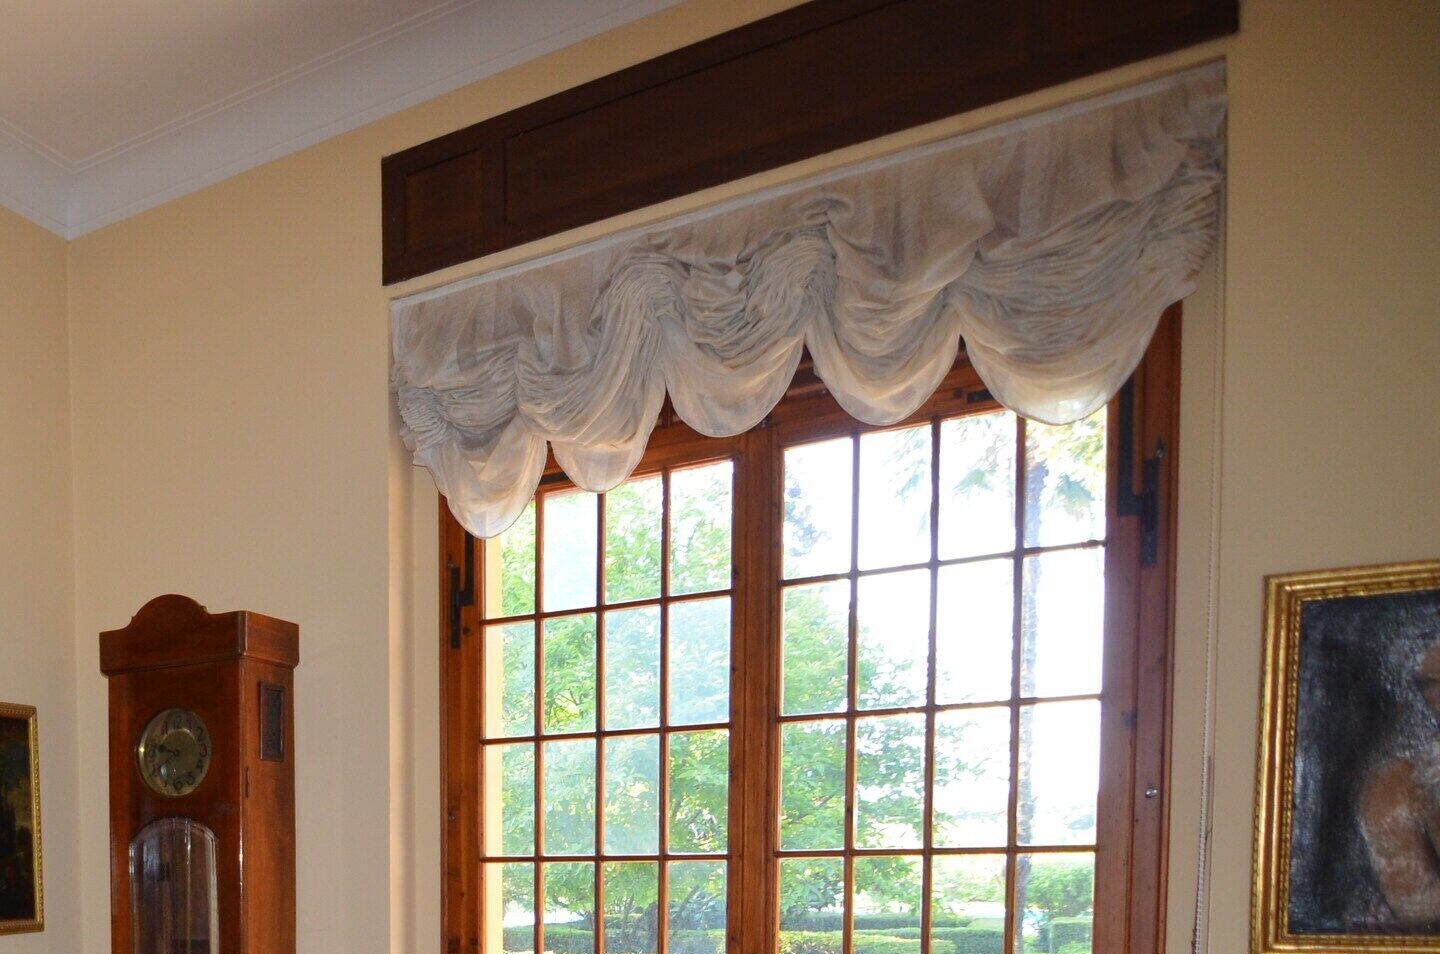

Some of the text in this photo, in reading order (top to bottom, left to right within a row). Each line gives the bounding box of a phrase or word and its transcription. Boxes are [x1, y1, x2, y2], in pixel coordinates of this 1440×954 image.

[196, 726, 204, 741] 2
[200, 743, 207, 758] 3
[196, 759, 204, 773] 4
[173, 776, 183, 791] 6
[186, 771, 195, 785] 5
